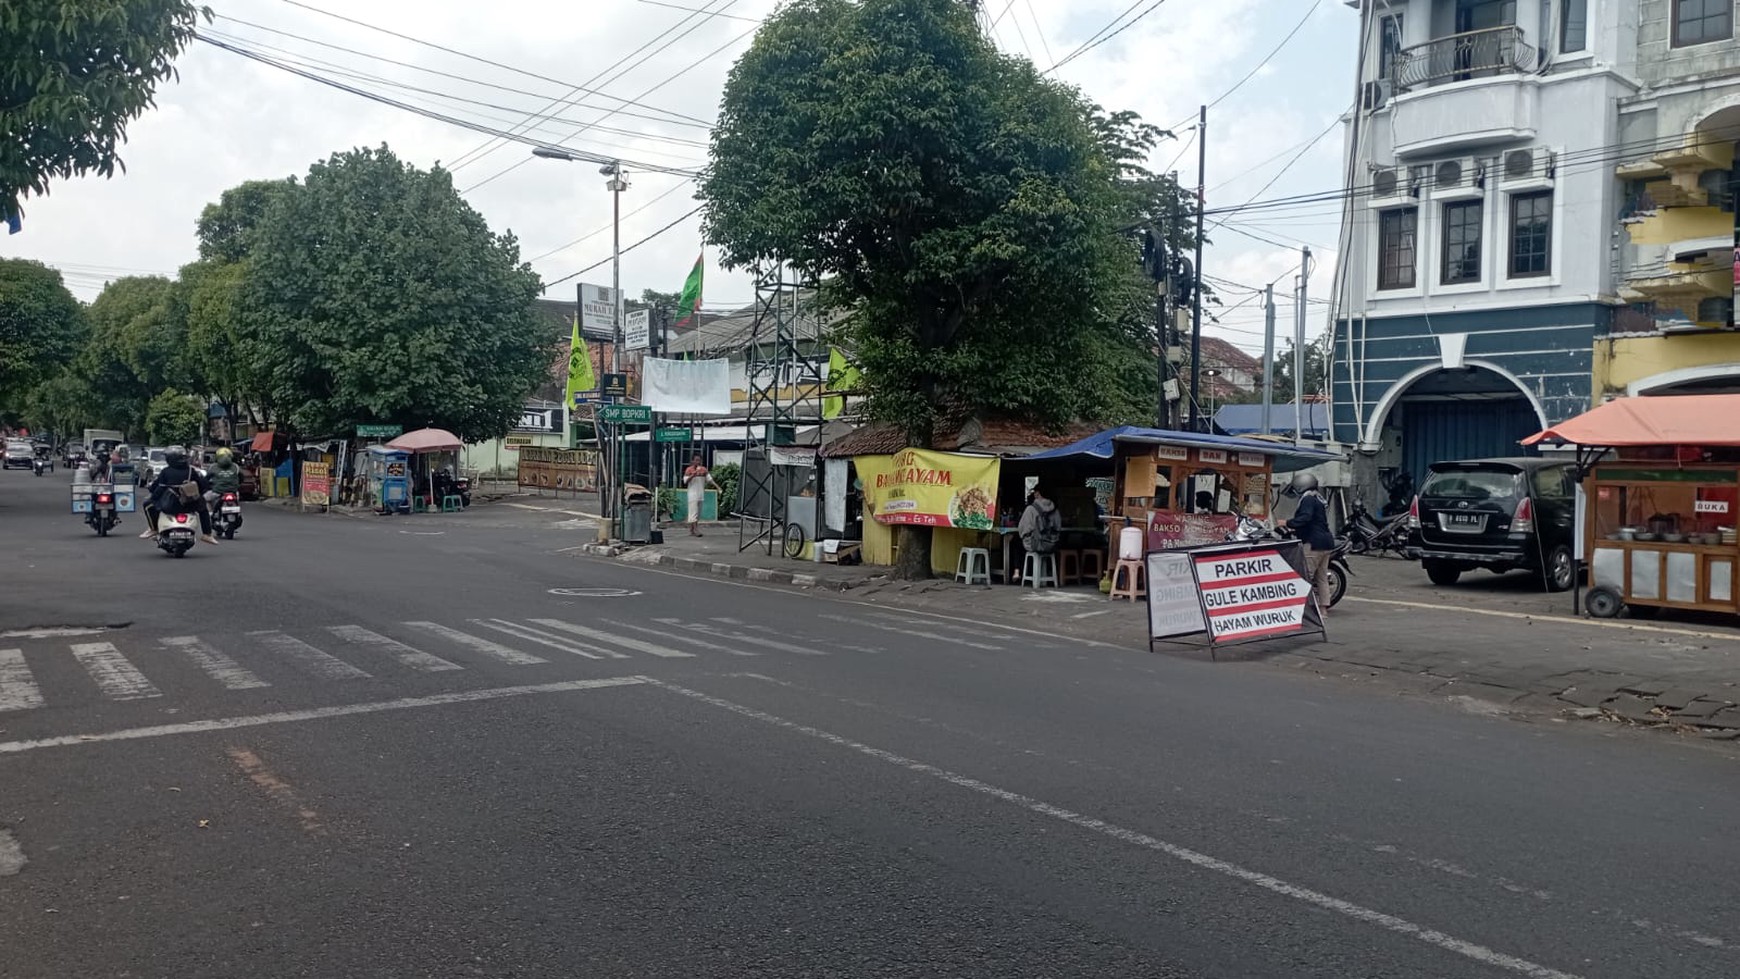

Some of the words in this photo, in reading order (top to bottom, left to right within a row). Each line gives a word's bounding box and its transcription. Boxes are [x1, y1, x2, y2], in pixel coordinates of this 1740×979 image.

[605, 408, 620, 418] SMP
[622, 409, 646, 419] BOPKRI
[906, 467, 953, 487] AYAM
[1153, 523, 1181, 533] BAKSO
[1214, 559, 1273, 578] PARKIR
[1205, 590, 1239, 607] GULE
[1240, 582, 1297, 604] KAMBING
[1214, 616, 1253, 632] HAYAM
[1252, 610, 1296, 626] WURUK
